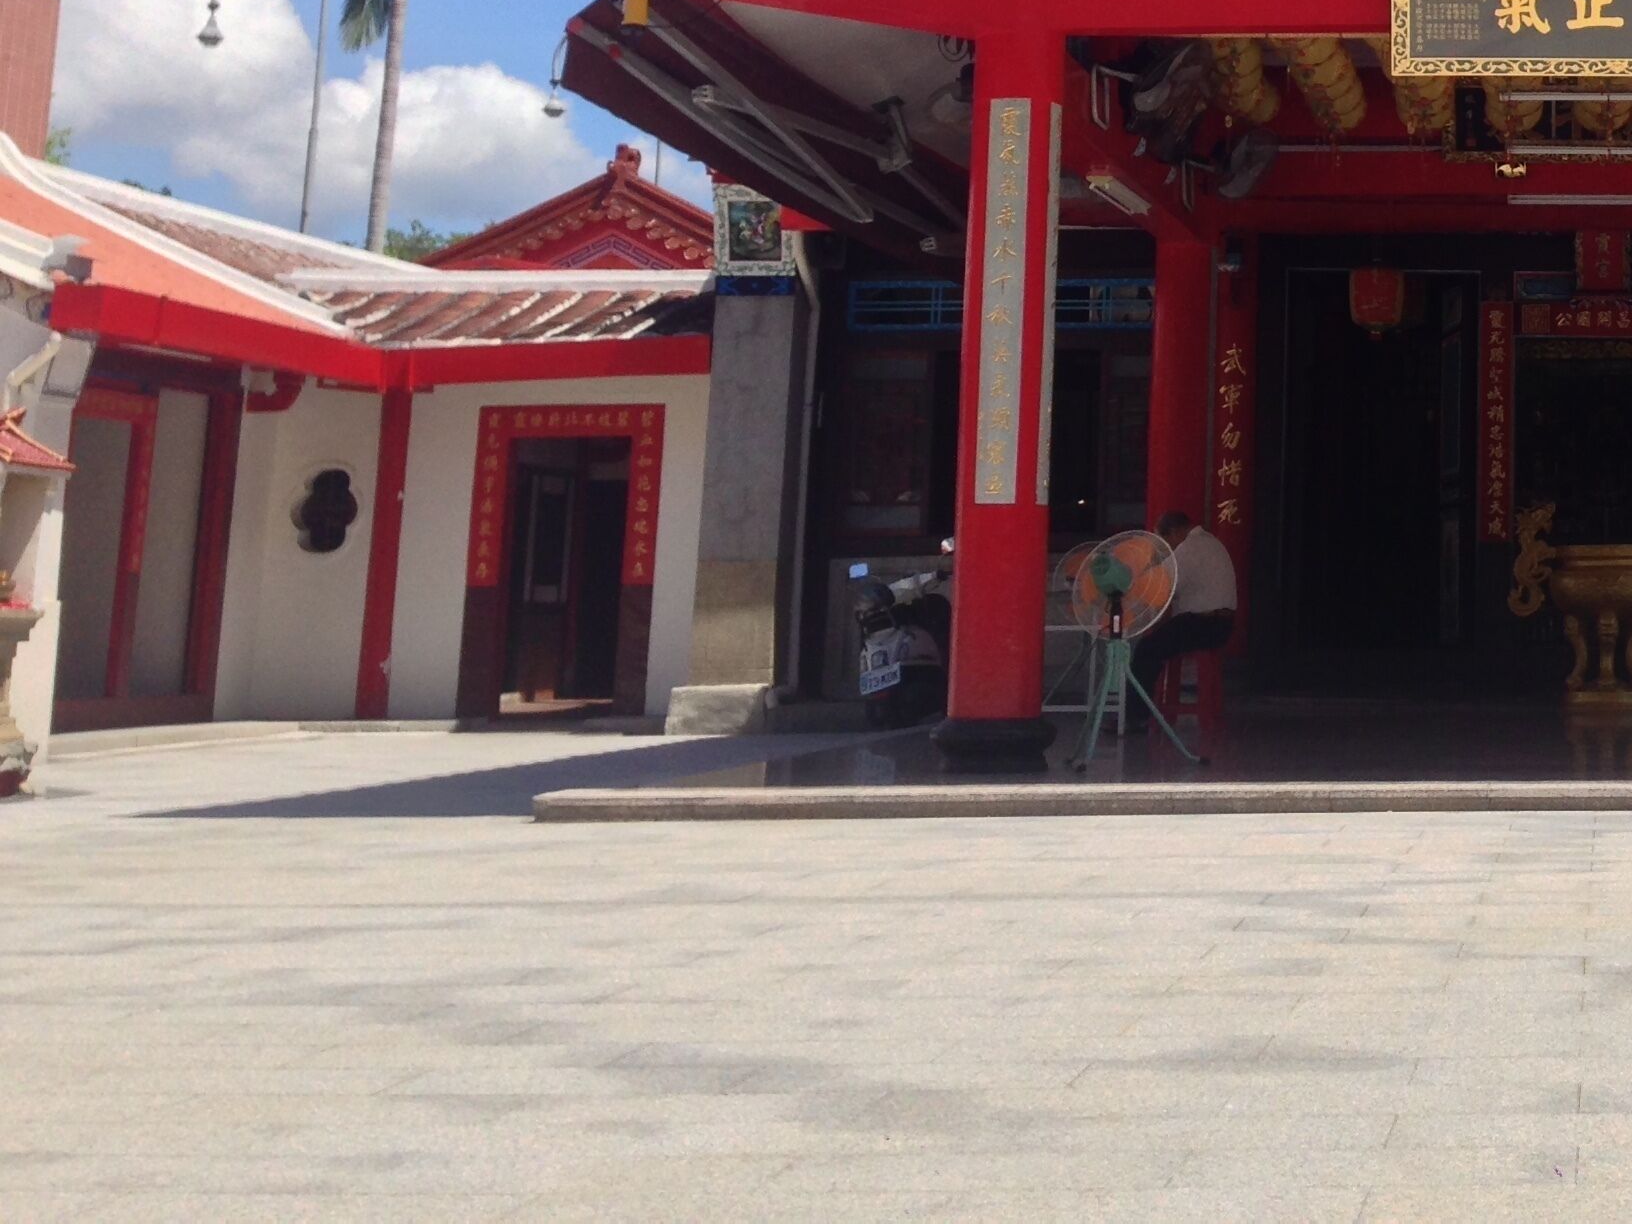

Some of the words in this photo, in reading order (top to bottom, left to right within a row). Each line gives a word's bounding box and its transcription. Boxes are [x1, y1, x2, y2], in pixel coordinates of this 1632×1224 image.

[1217, 344, 1247, 525] 武軍勿惜死
